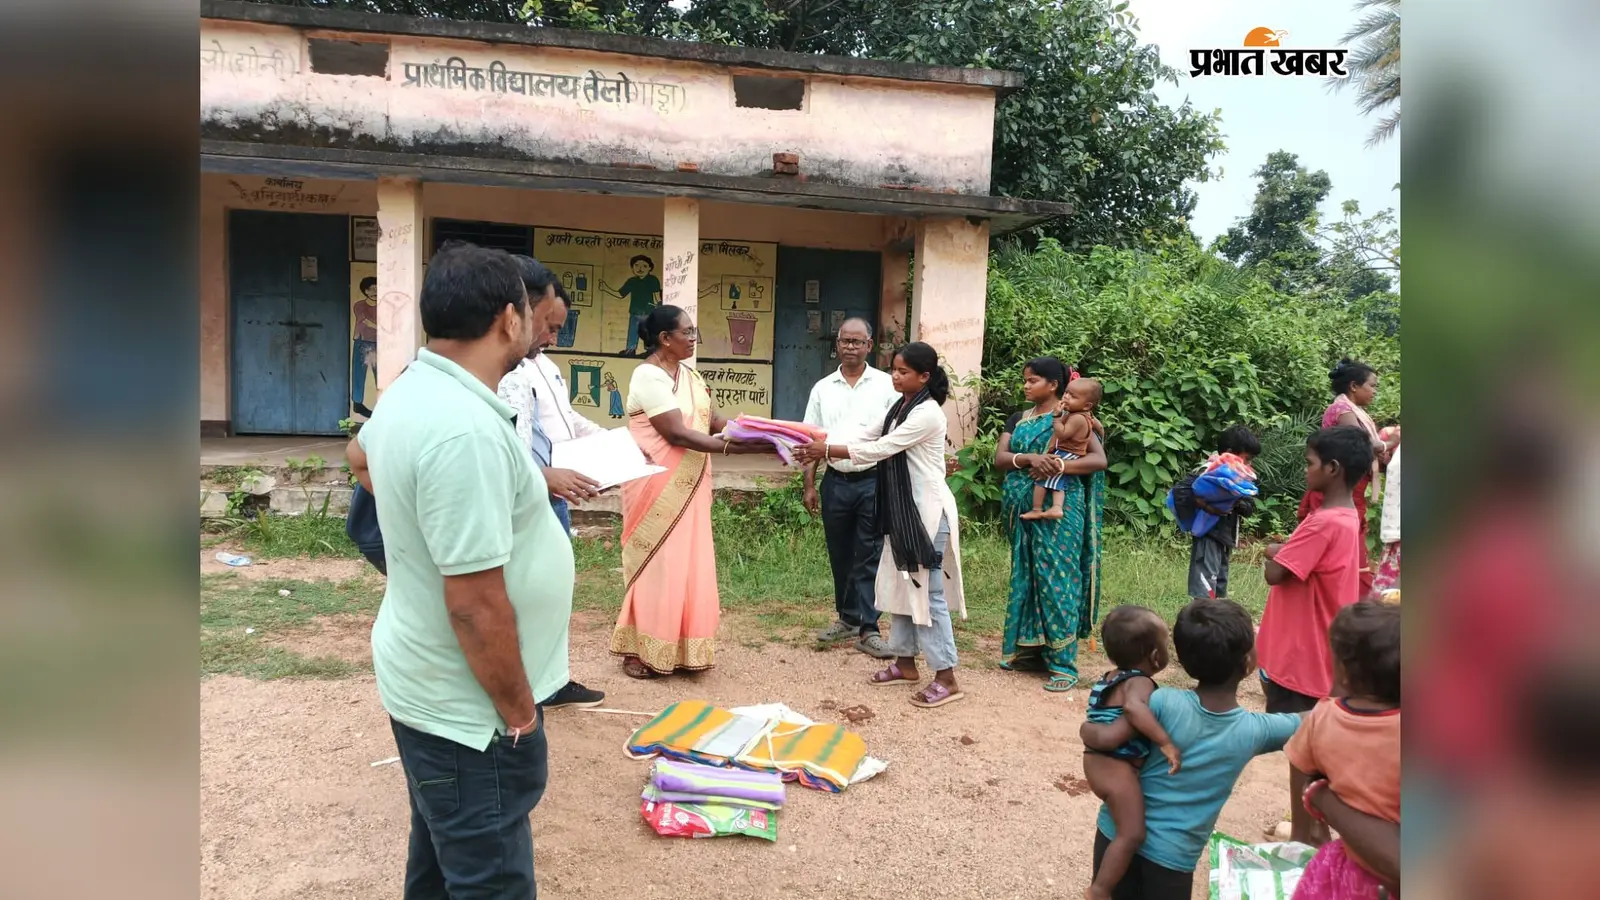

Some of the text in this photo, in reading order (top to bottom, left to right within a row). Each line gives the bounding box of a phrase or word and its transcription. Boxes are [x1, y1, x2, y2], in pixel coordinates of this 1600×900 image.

[546, 232, 572, 247] अपनी
[574, 235, 602, 248] धरती
[604, 237, 631, 252] अपना
[700, 243, 716, 255] हम
[718, 241, 752, 257] मिलकर
[715, 388, 748, 408] सुरक्षा
